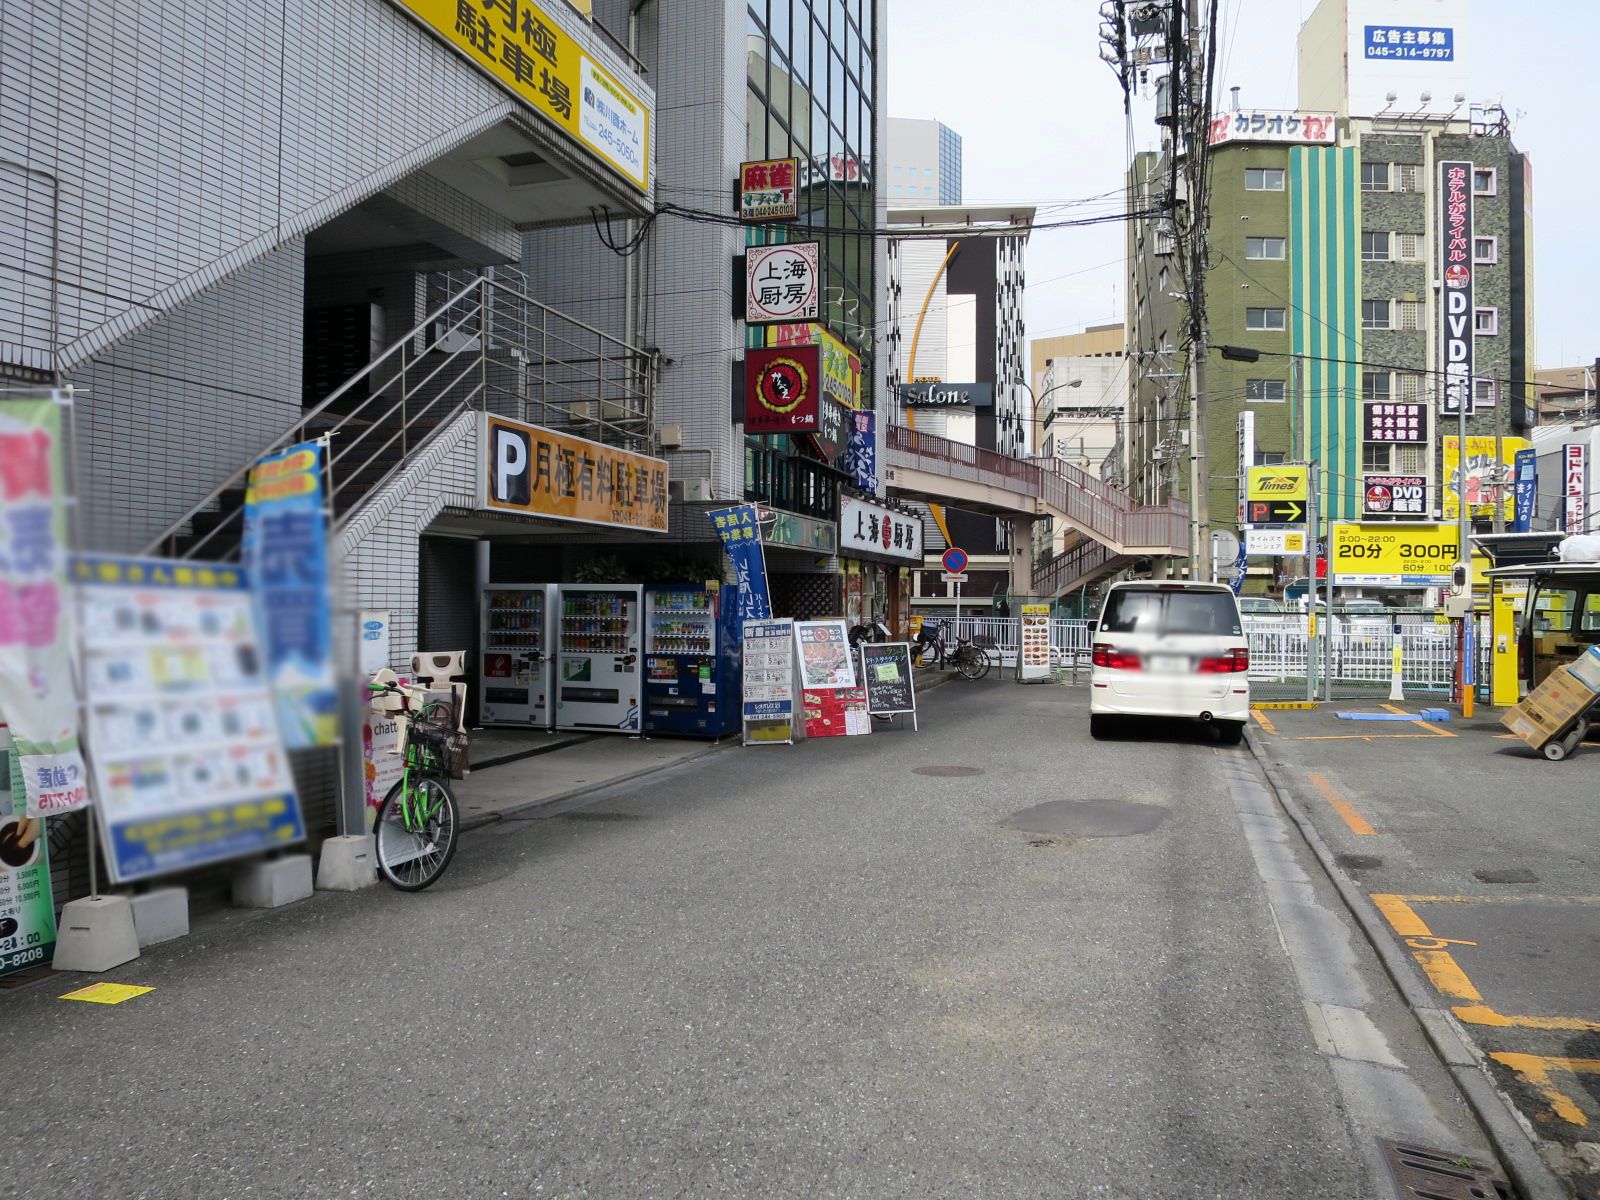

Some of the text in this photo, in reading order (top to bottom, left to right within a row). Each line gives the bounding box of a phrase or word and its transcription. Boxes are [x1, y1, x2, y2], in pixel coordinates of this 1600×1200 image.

[1372, 29, 1446, 45] 広告主募集
[455, 0, 572, 120] 駐車場
[1368, 46, 1451, 58] 045-314-9797
[744, 163, 793, 190] 麻雀
[1448, 167, 1467, 262] ホテルがライバル
[758, 259, 807, 281] 上海
[758, 283, 807, 305] 厨房
[802, 307, 816, 316] 1F
[906, 385, 970, 405] Salone
[1372, 405, 1419, 415] 個別空調
[1372, 417, 1419, 428] 完全個室
[1372, 429, 1419, 440] 完全防音
[498, 430, 666, 514] P 月極有料駐車場
[1568, 446, 1582, 496] ヨドバシ
[1258, 477, 1299, 491] Times
[1392, 486, 1423, 499] DVD
[1253, 503, 1268, 522] P
[853, 510, 880, 544] 上海
